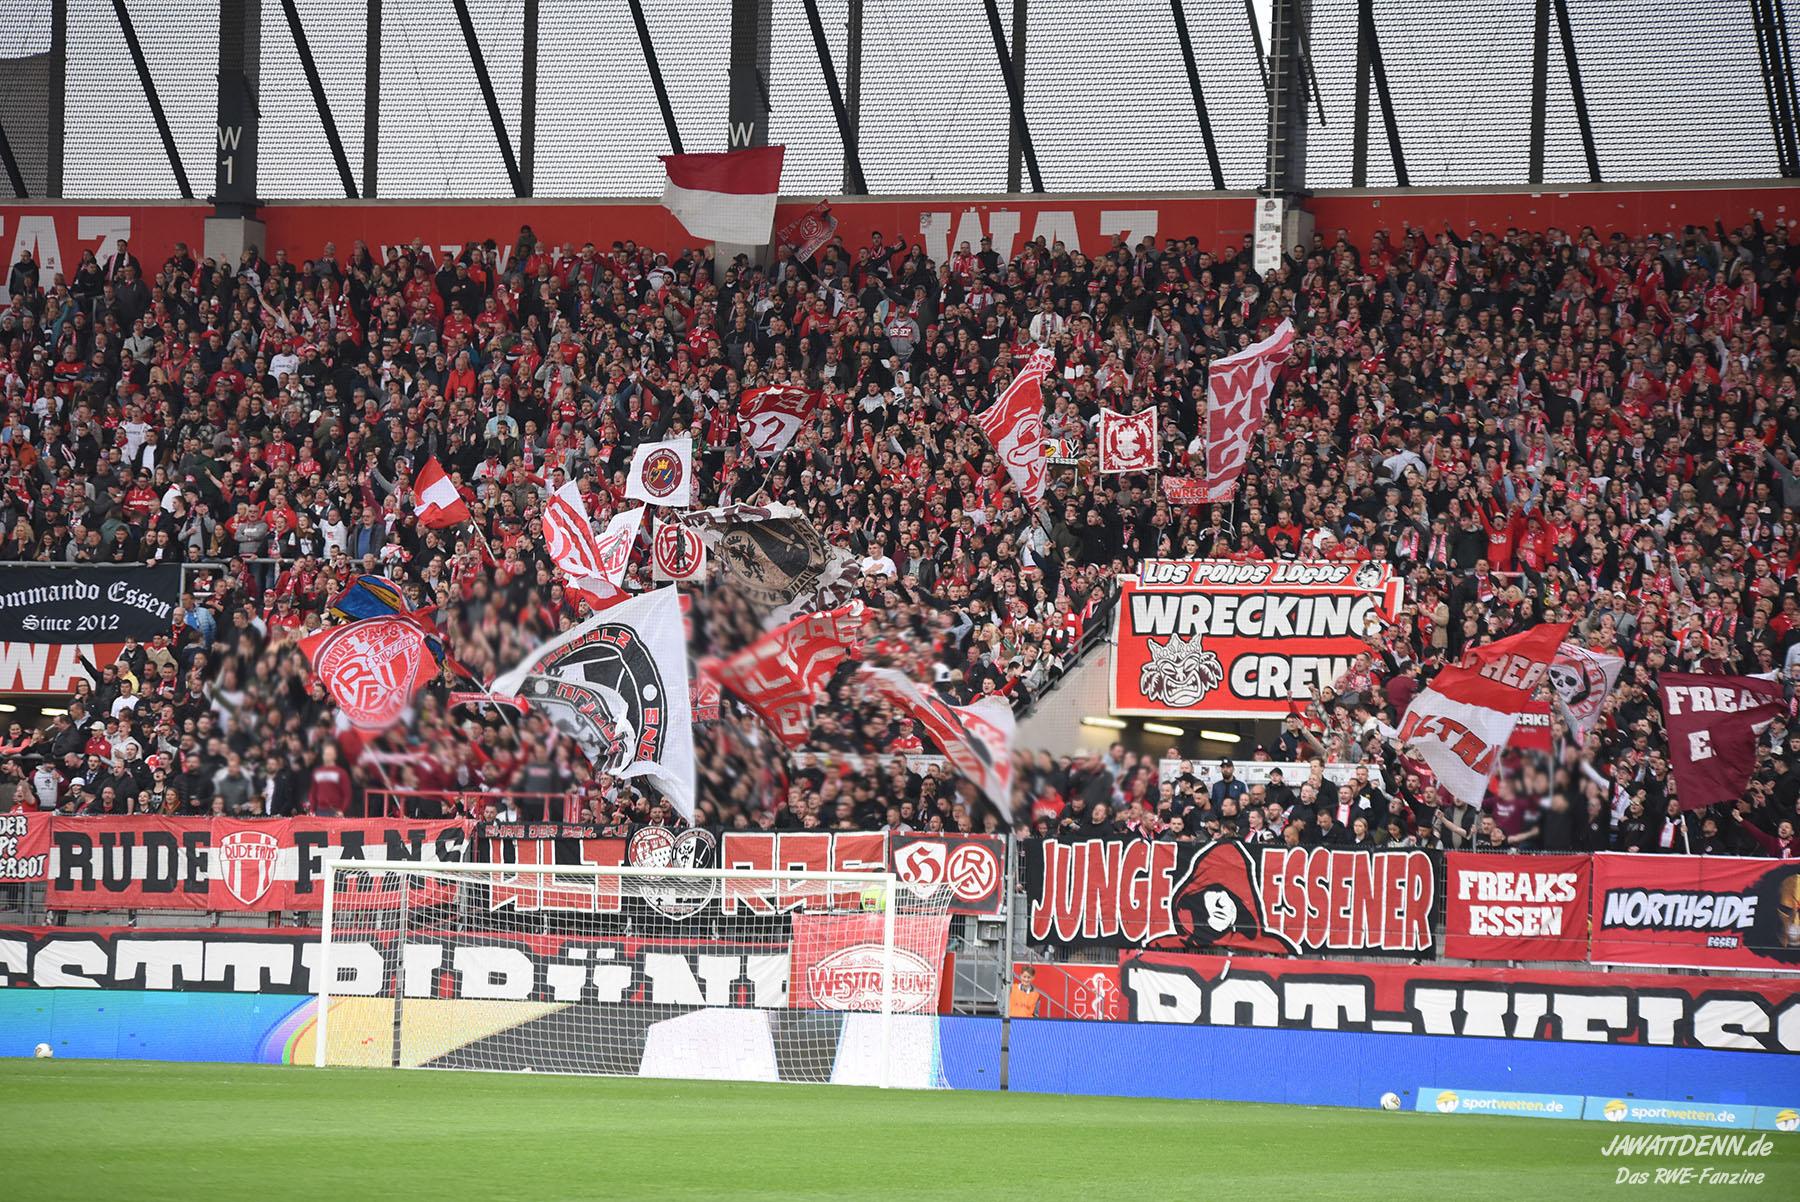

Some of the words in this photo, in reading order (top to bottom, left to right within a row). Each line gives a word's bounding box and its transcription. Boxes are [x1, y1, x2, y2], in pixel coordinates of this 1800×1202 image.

[218, 126, 242, 150] W
[729, 122, 754, 147] W
[222, 155, 233, 184] 1
[1143, 563, 1190, 585] LOS
[1271, 563, 1350, 586] LOCOS
[108, 580, 172, 619] Essen
[22, 614, 71, 631] Since
[76, 614, 120, 631] 2012
[1131, 593, 1385, 638] WRECKING
[53, 830, 211, 894] RUDE
[224, 843, 253, 860] RUDE
[254, 844, 277, 860] FANS
[1030, 838, 1179, 942] JUNGE
[1261, 846, 1434, 952] ESSENER
[1457, 869, 1578, 903] FREAKS
[1468, 905, 1563, 937] ESSEN
[1603, 890, 1758, 930] NORTHSIDE
[1706, 936, 1738, 949] ESSEN
[1462, 1096, 1565, 1114] sportwetten.de
[1630, 1105, 1736, 1124] sportwetten.de
